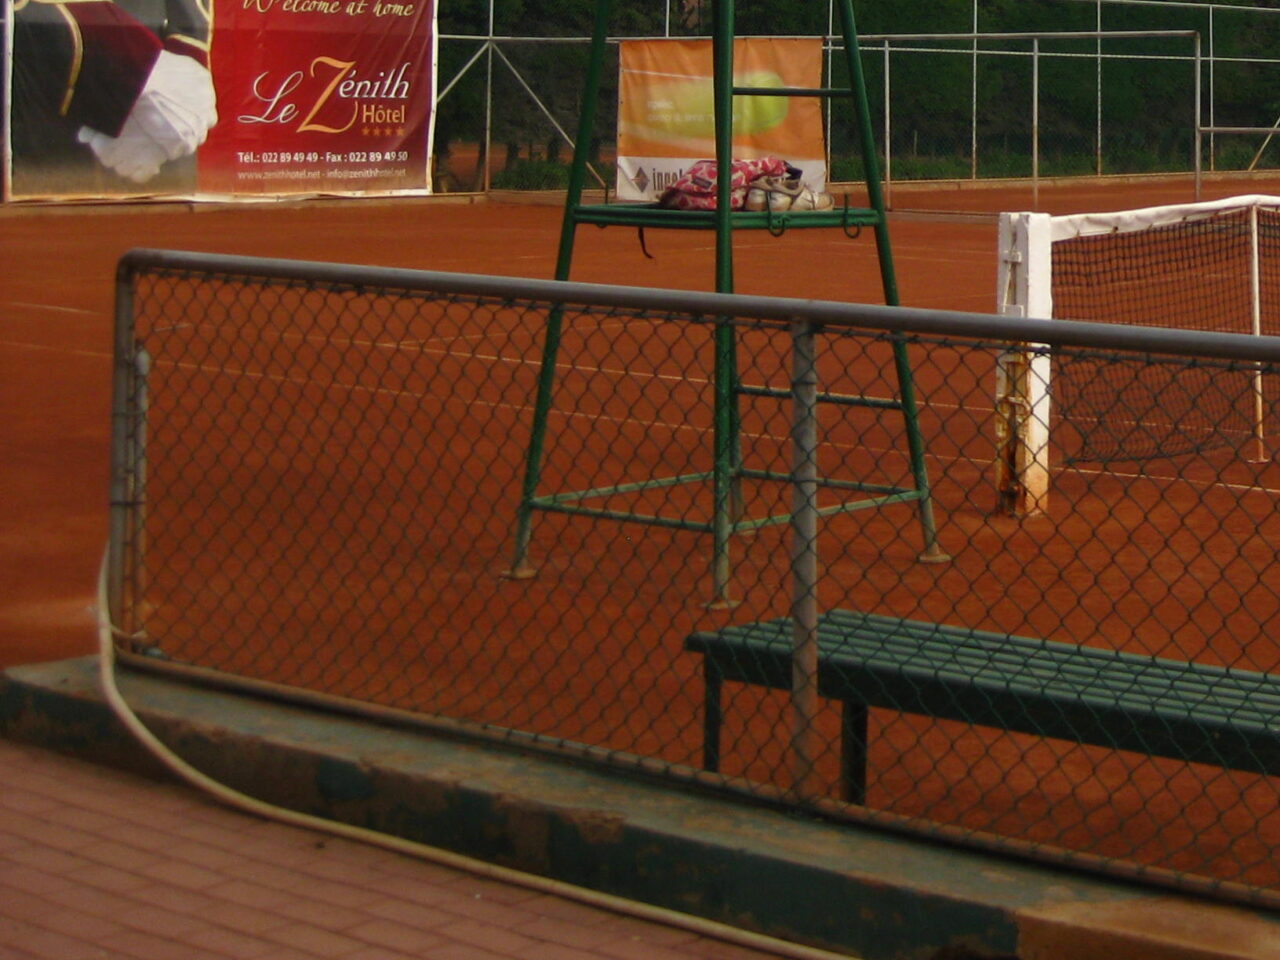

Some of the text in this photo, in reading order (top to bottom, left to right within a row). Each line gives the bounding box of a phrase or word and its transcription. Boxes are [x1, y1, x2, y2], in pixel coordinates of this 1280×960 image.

[237, 56, 411, 134] Le Zénith
[362, 104, 405, 124] Hôtel
[262, 152, 278, 163] 022
[280, 152, 292, 163] 89
[293, 152, 304, 163] 49
[306, 152, 318, 163] 49
[326, 152, 342, 163] Fax
[349, 152, 367, 162] 022
[369, 152, 382, 162] 89
[383, 152, 396, 162] 49
